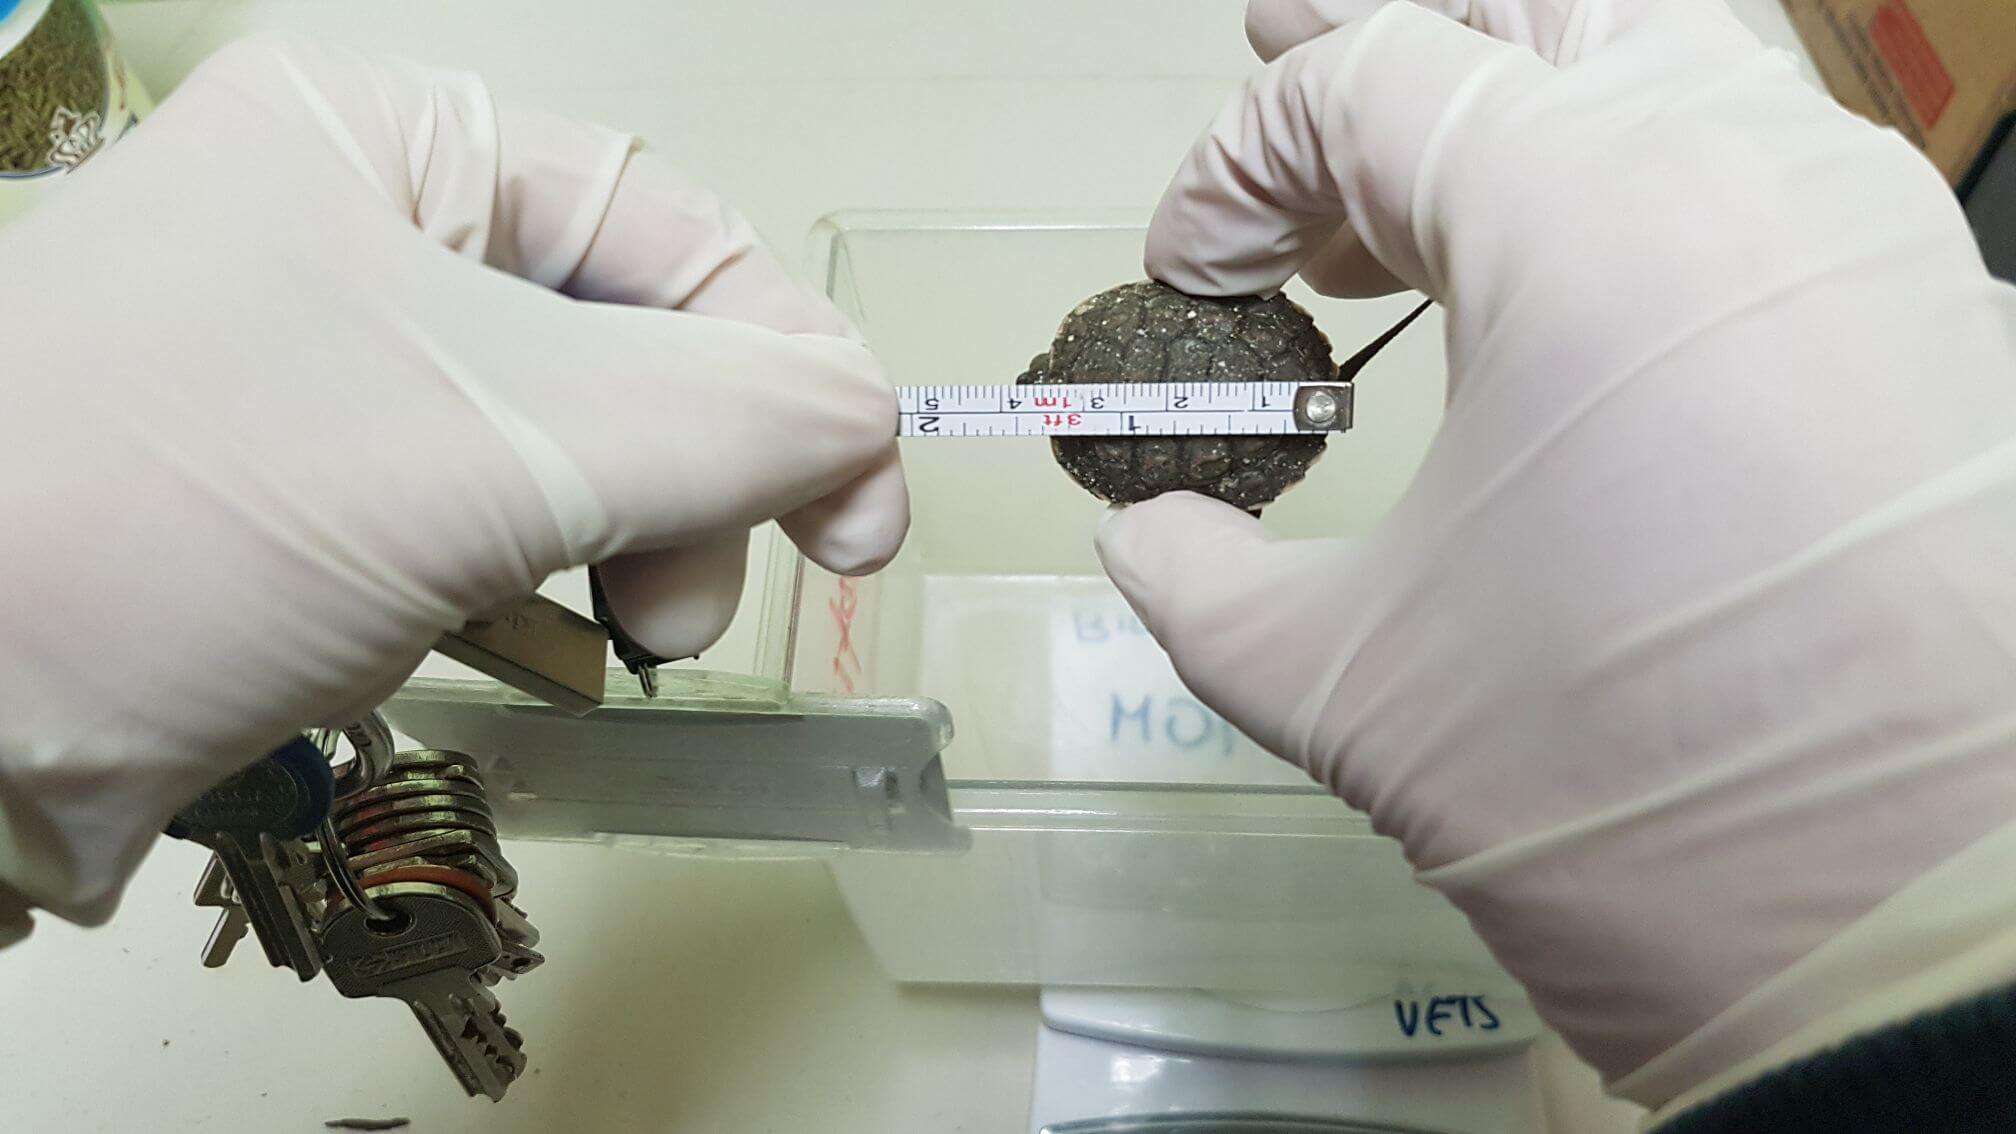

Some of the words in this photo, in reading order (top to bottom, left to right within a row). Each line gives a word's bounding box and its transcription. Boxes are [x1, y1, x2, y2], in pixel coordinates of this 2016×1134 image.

[925, 398, 940, 411] 5
[1009, 398, 1022, 410] 4
[1091, 397, 1104, 409] 3
[1174, 396, 1188, 408] 2
[919, 416, 940, 433] 2
[1394, 994, 1501, 1037] VETS
